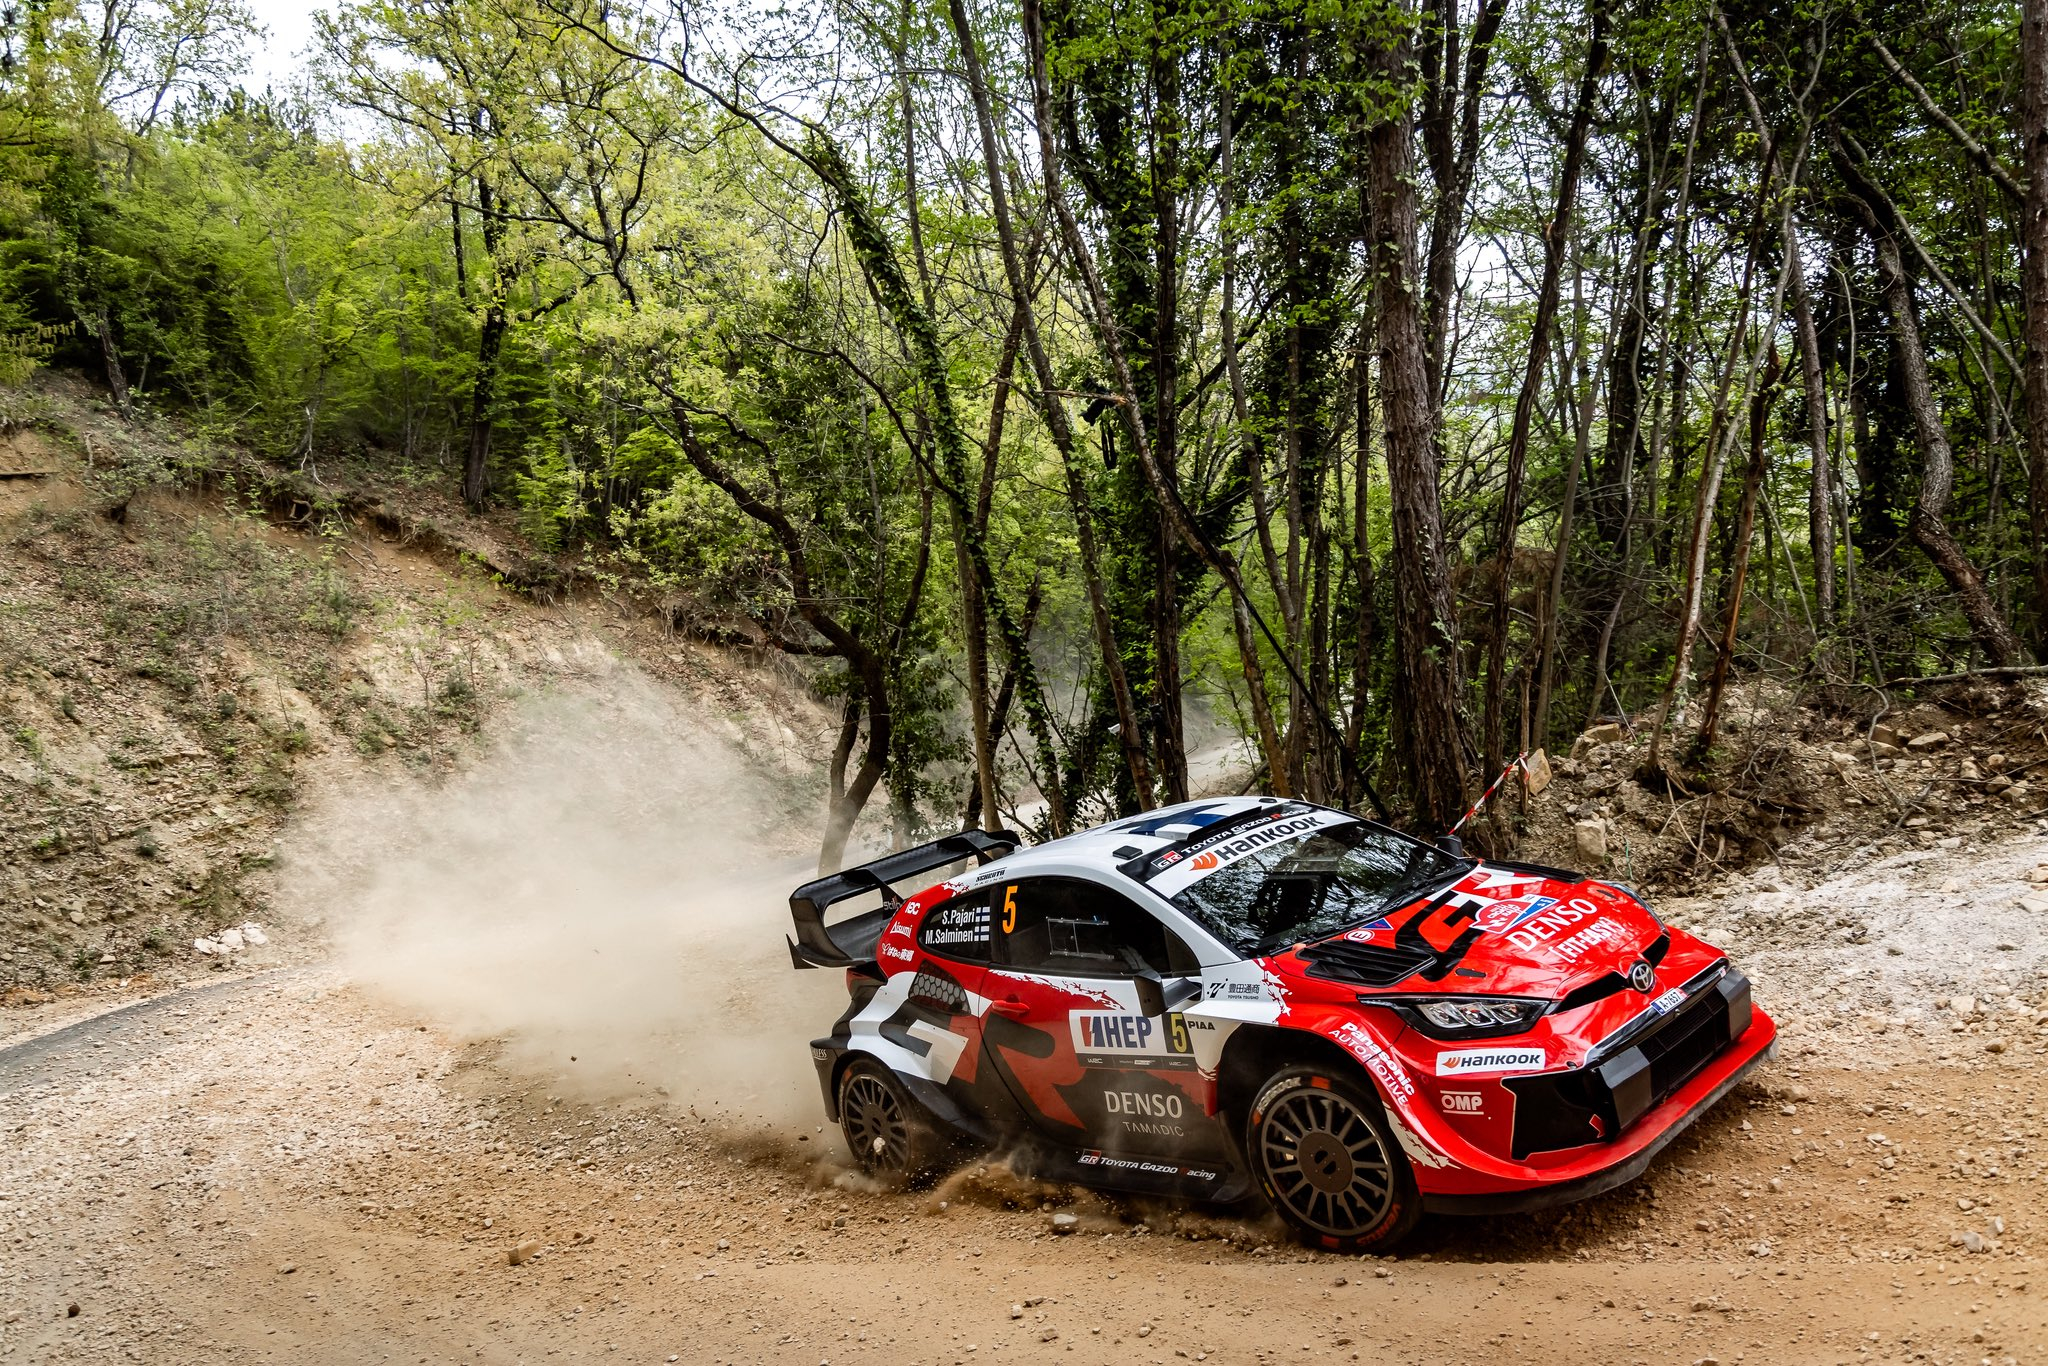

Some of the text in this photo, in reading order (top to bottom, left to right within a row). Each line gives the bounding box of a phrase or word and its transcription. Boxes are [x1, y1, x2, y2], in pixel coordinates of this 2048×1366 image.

[1180, 830, 1232, 854] TOYOTA
[1231, 817, 1272, 835] GAZOO
[942, 908, 975, 927] S.Pajari
[1002, 885, 1018, 934] 5
[925, 928, 974, 945] M.Salminen
[1505, 898, 1598, 952] DENSO
[1170, 1013, 1187, 1053] 5
[1188, 1020, 1216, 1031] PIAA
[1328, 1030, 1408, 1106] AUTOMOTIVE
[1340, 1022, 1415, 1096] Panasonic
[1103, 1091, 1183, 1119] DENSO
[1441, 1094, 1483, 1111] OMP
[1122, 1121, 1185, 1137] TAMADIC
[1079, 1154, 1216, 1181] GR TOYOTA GAZOO Racing
